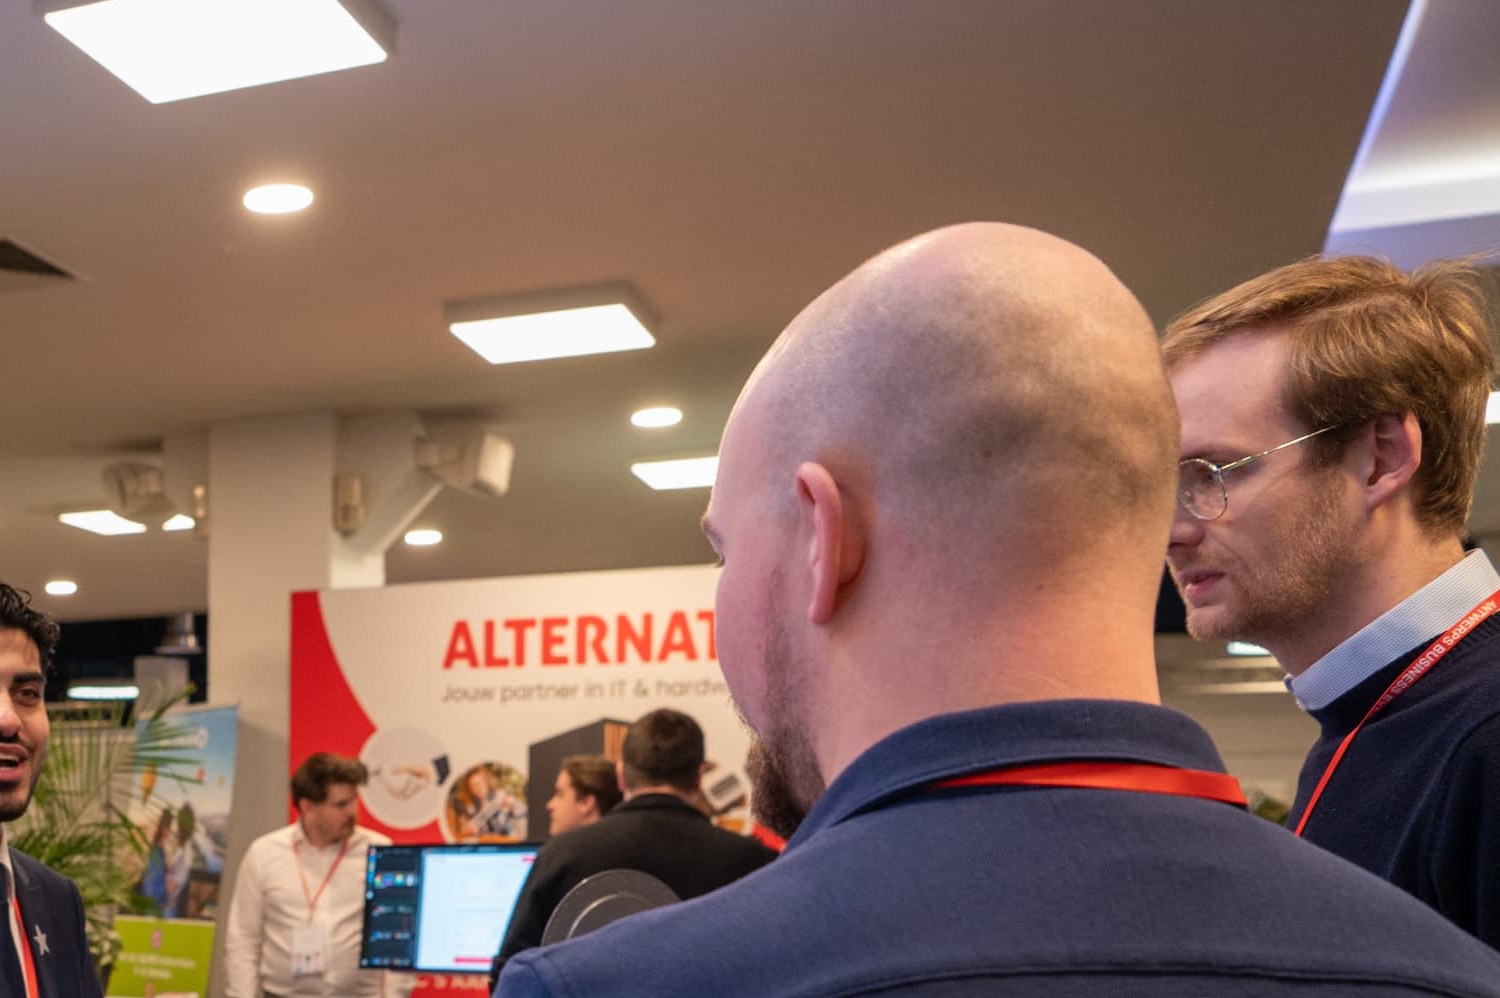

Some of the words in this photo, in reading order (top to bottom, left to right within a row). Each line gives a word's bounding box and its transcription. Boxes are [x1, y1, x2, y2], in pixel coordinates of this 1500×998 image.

[1442, 599, 1497, 646] ANTWERPS
[442, 683, 495, 703] Jouw
[500, 681, 578, 704] partner
[585, 679, 602, 698] in
[609, 679, 628, 697] IT
[632, 677, 649, 697] &
[1390, 643, 1445, 695] BUSINESS
